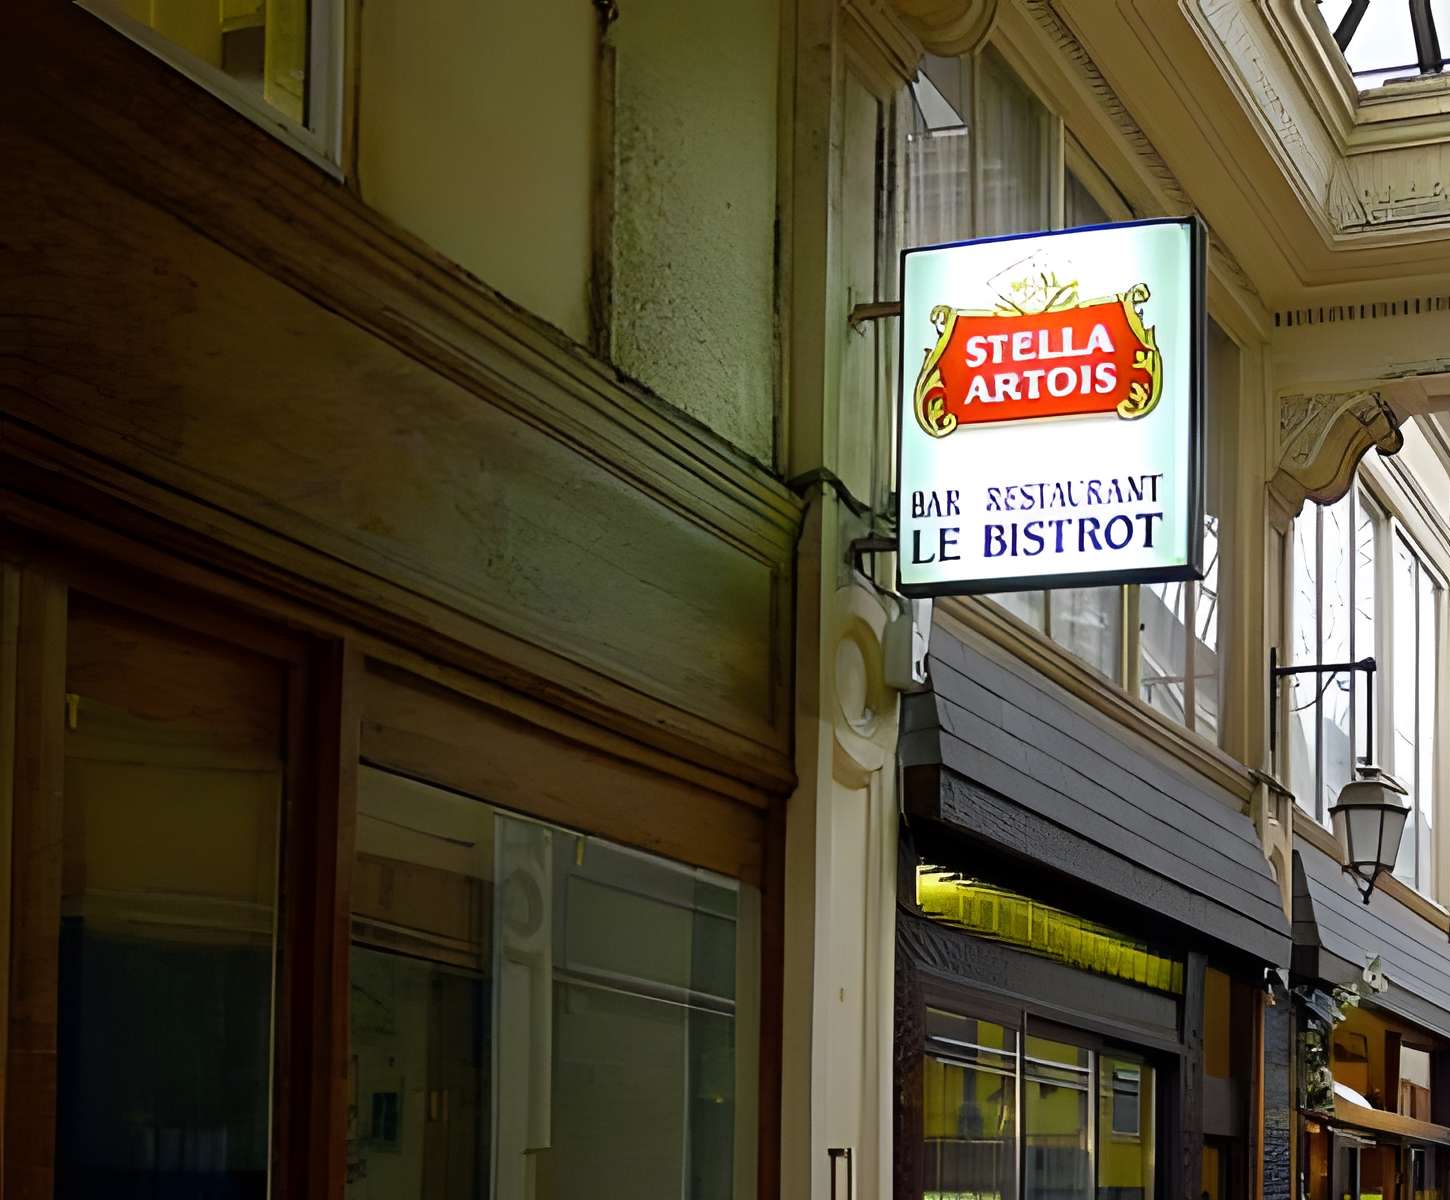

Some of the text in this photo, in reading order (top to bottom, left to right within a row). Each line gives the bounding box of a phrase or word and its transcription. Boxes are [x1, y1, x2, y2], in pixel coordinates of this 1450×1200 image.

[965, 323, 1115, 367] STELLA
[963, 362, 1117, 405] ARTOIS
[911, 473, 1163, 519] BAR RESTAURANT
[911, 512, 1163, 565] LE BISTROT
